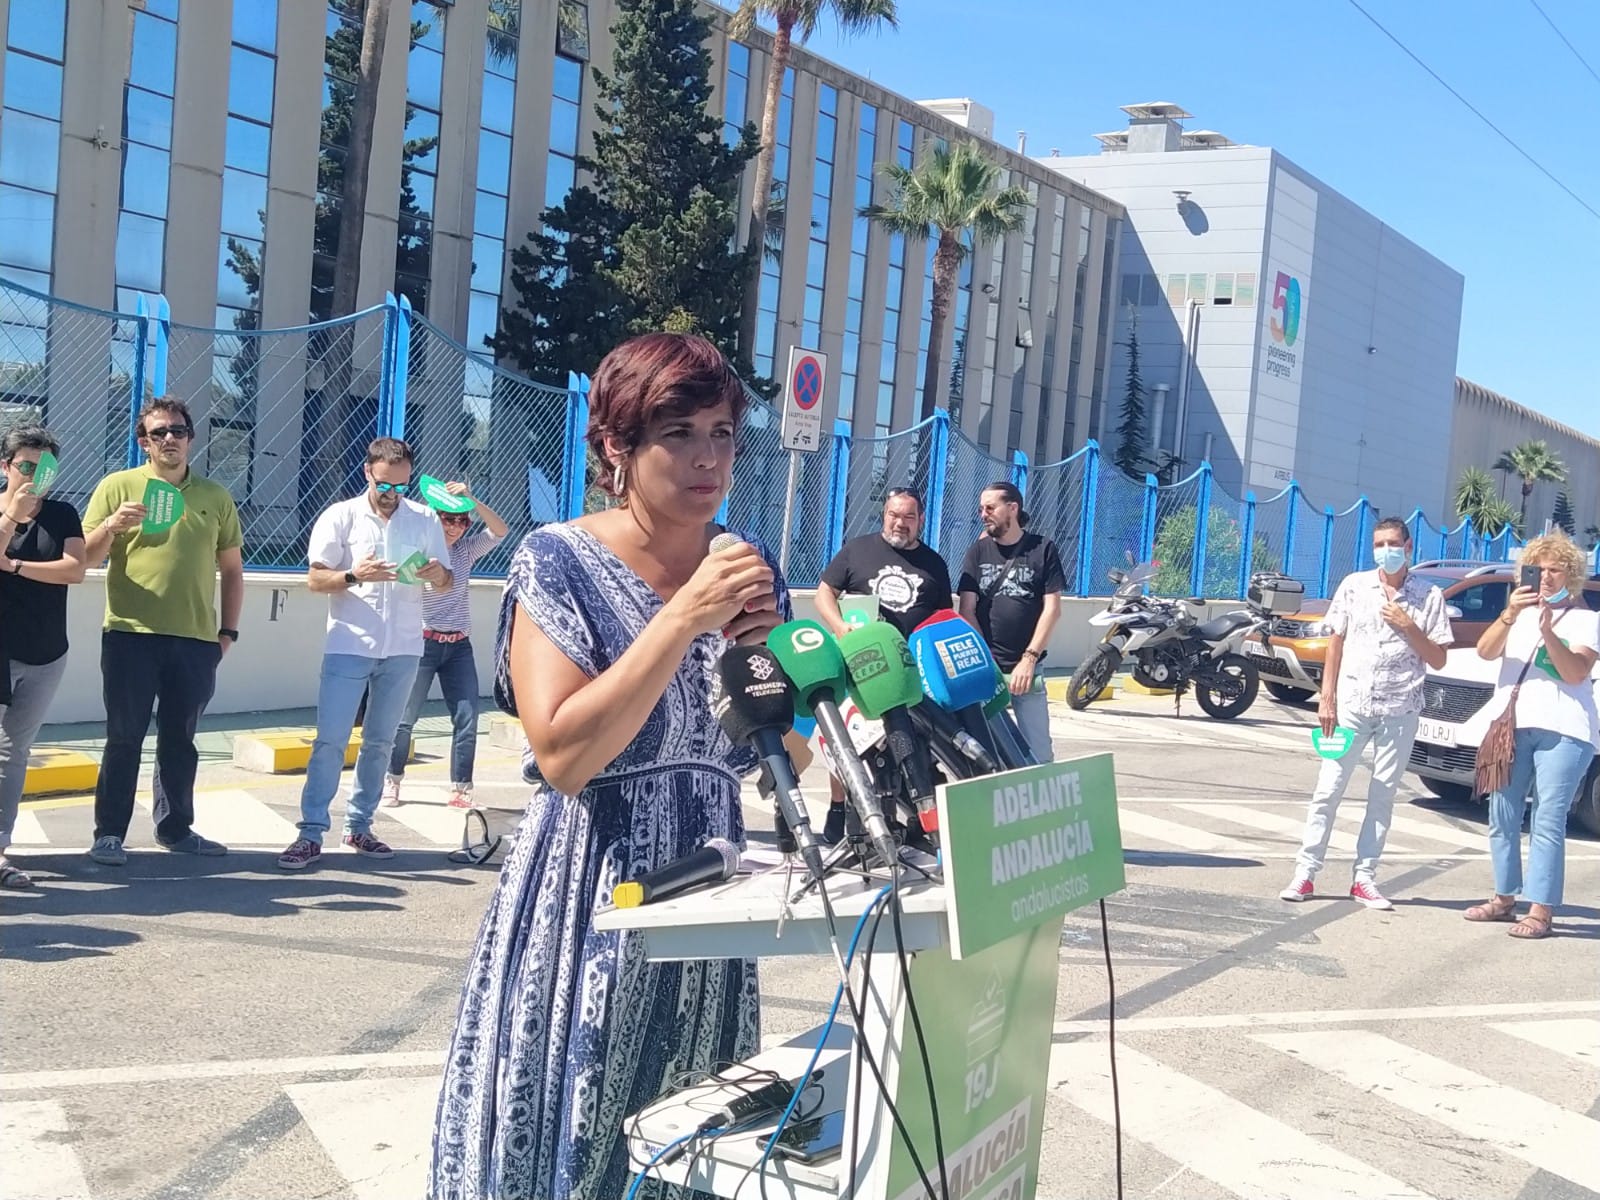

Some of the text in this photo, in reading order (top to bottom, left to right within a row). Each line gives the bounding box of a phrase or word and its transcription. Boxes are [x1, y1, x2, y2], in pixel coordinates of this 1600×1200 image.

[1267, 342, 1296, 368] pioneering
[1266, 360, 1291, 377] progress
[947, 638, 975, 653] TELE
[952, 648, 979, 661] PUERTO
[956, 655, 984, 670] REAL
[744, 681, 788, 694] ATRESMEDIA
[993, 771, 1083, 828] ADELANTE
[991, 811, 1095, 887] ANDALUCÍA
[1011, 872, 1089, 924] andalucistas
[965, 1053, 999, 1115] 19J
[914, 1109, 1026, 1200] ALUCÍA
